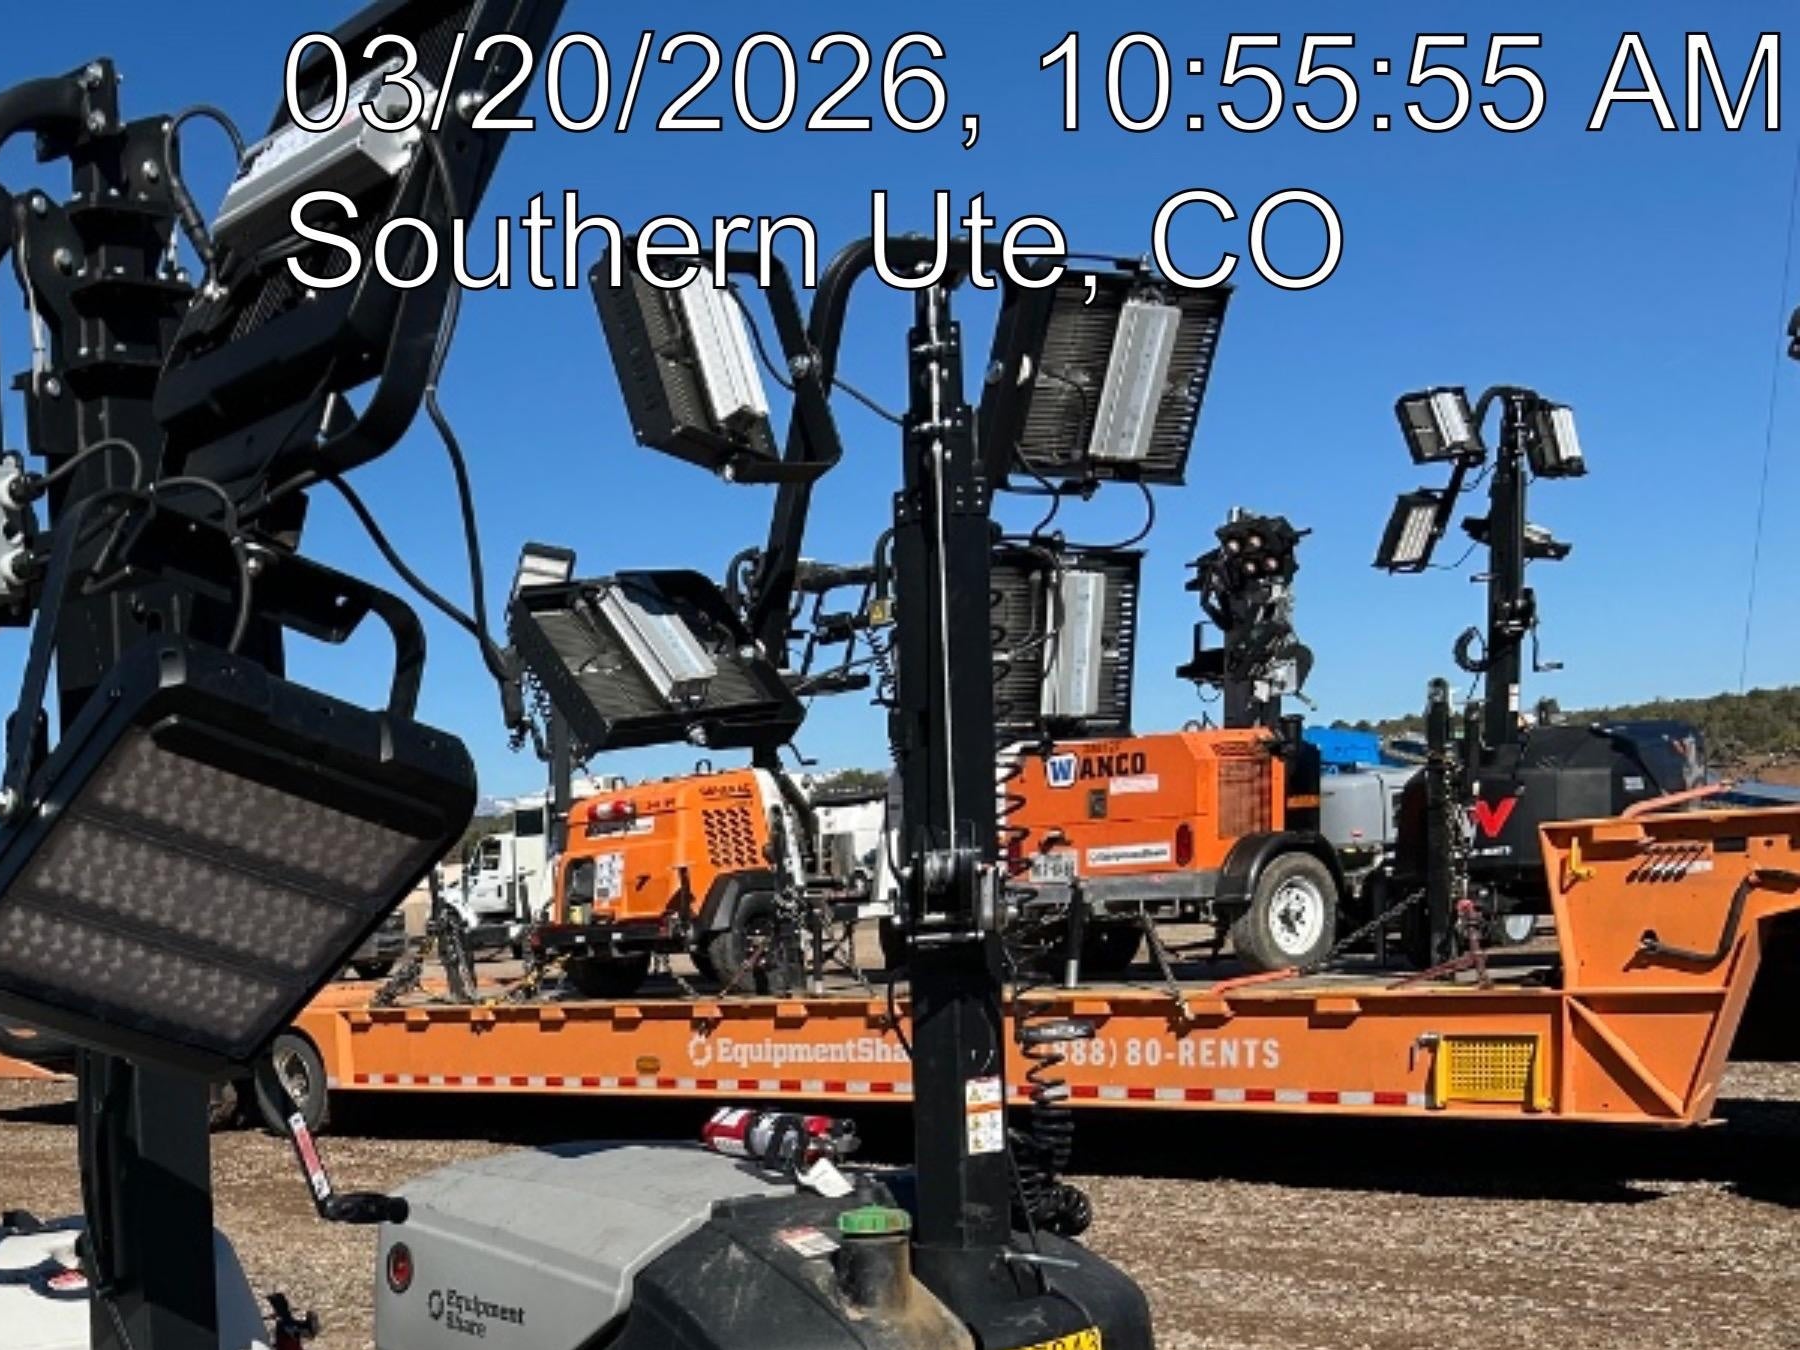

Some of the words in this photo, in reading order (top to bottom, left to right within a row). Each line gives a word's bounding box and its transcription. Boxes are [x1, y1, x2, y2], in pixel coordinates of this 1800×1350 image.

[1048, 752, 1146, 785] WANCO
[716, 1037, 912, 1069] EquipmentSha
[1126, 1038, 1280, 1069] 80-RENTS
[446, 1288, 525, 1326] Equipment
[446, 1310, 487, 1338] Share
